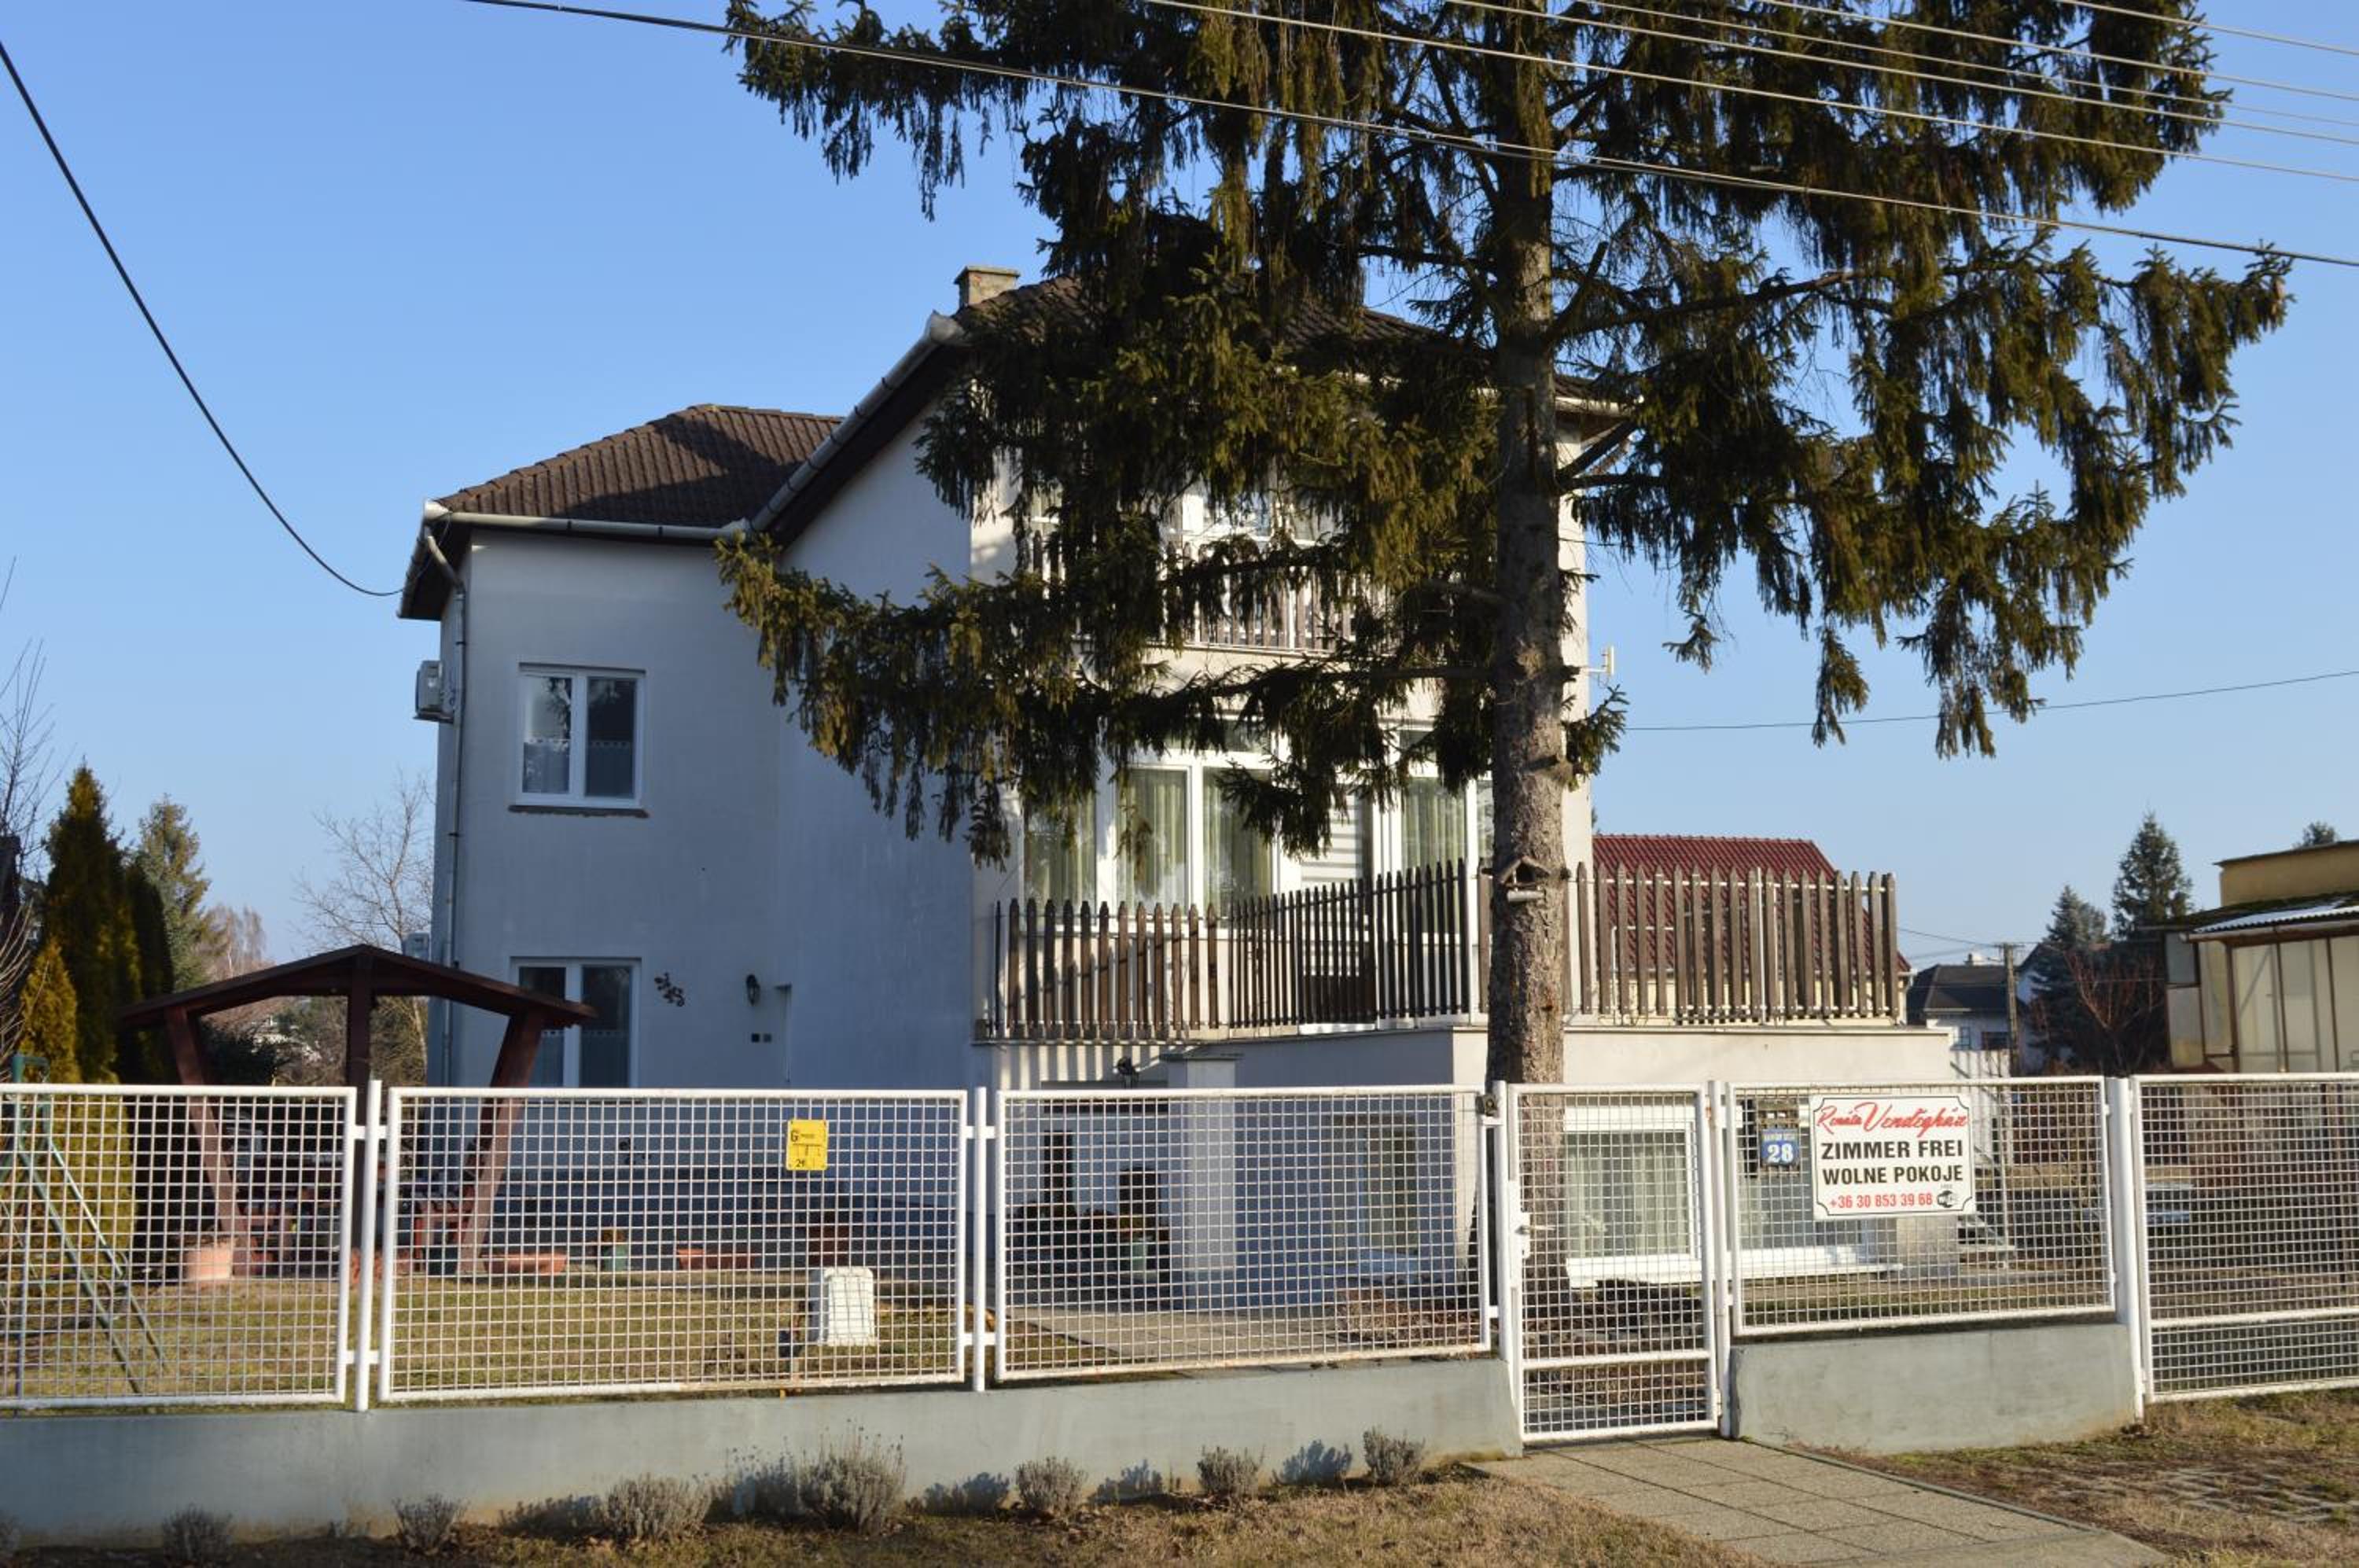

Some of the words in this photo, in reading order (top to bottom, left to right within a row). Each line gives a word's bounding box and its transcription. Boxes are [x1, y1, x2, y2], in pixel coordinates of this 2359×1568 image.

[1767, 1144, 1794, 1163] 28
[1820, 1141, 1911, 1160] ZIMMER
[1918, 1139, 1963, 1158] FREI
[1823, 1167, 1888, 1185] WOLNE
[1893, 1165, 1963, 1183] POKOJE
[1829, 1194, 1853, 1209] +36
[1857, 1194, 1871, 1208] 30
[1875, 1194, 1897, 1207] 853
[1901, 1193, 1915, 1206] 39
